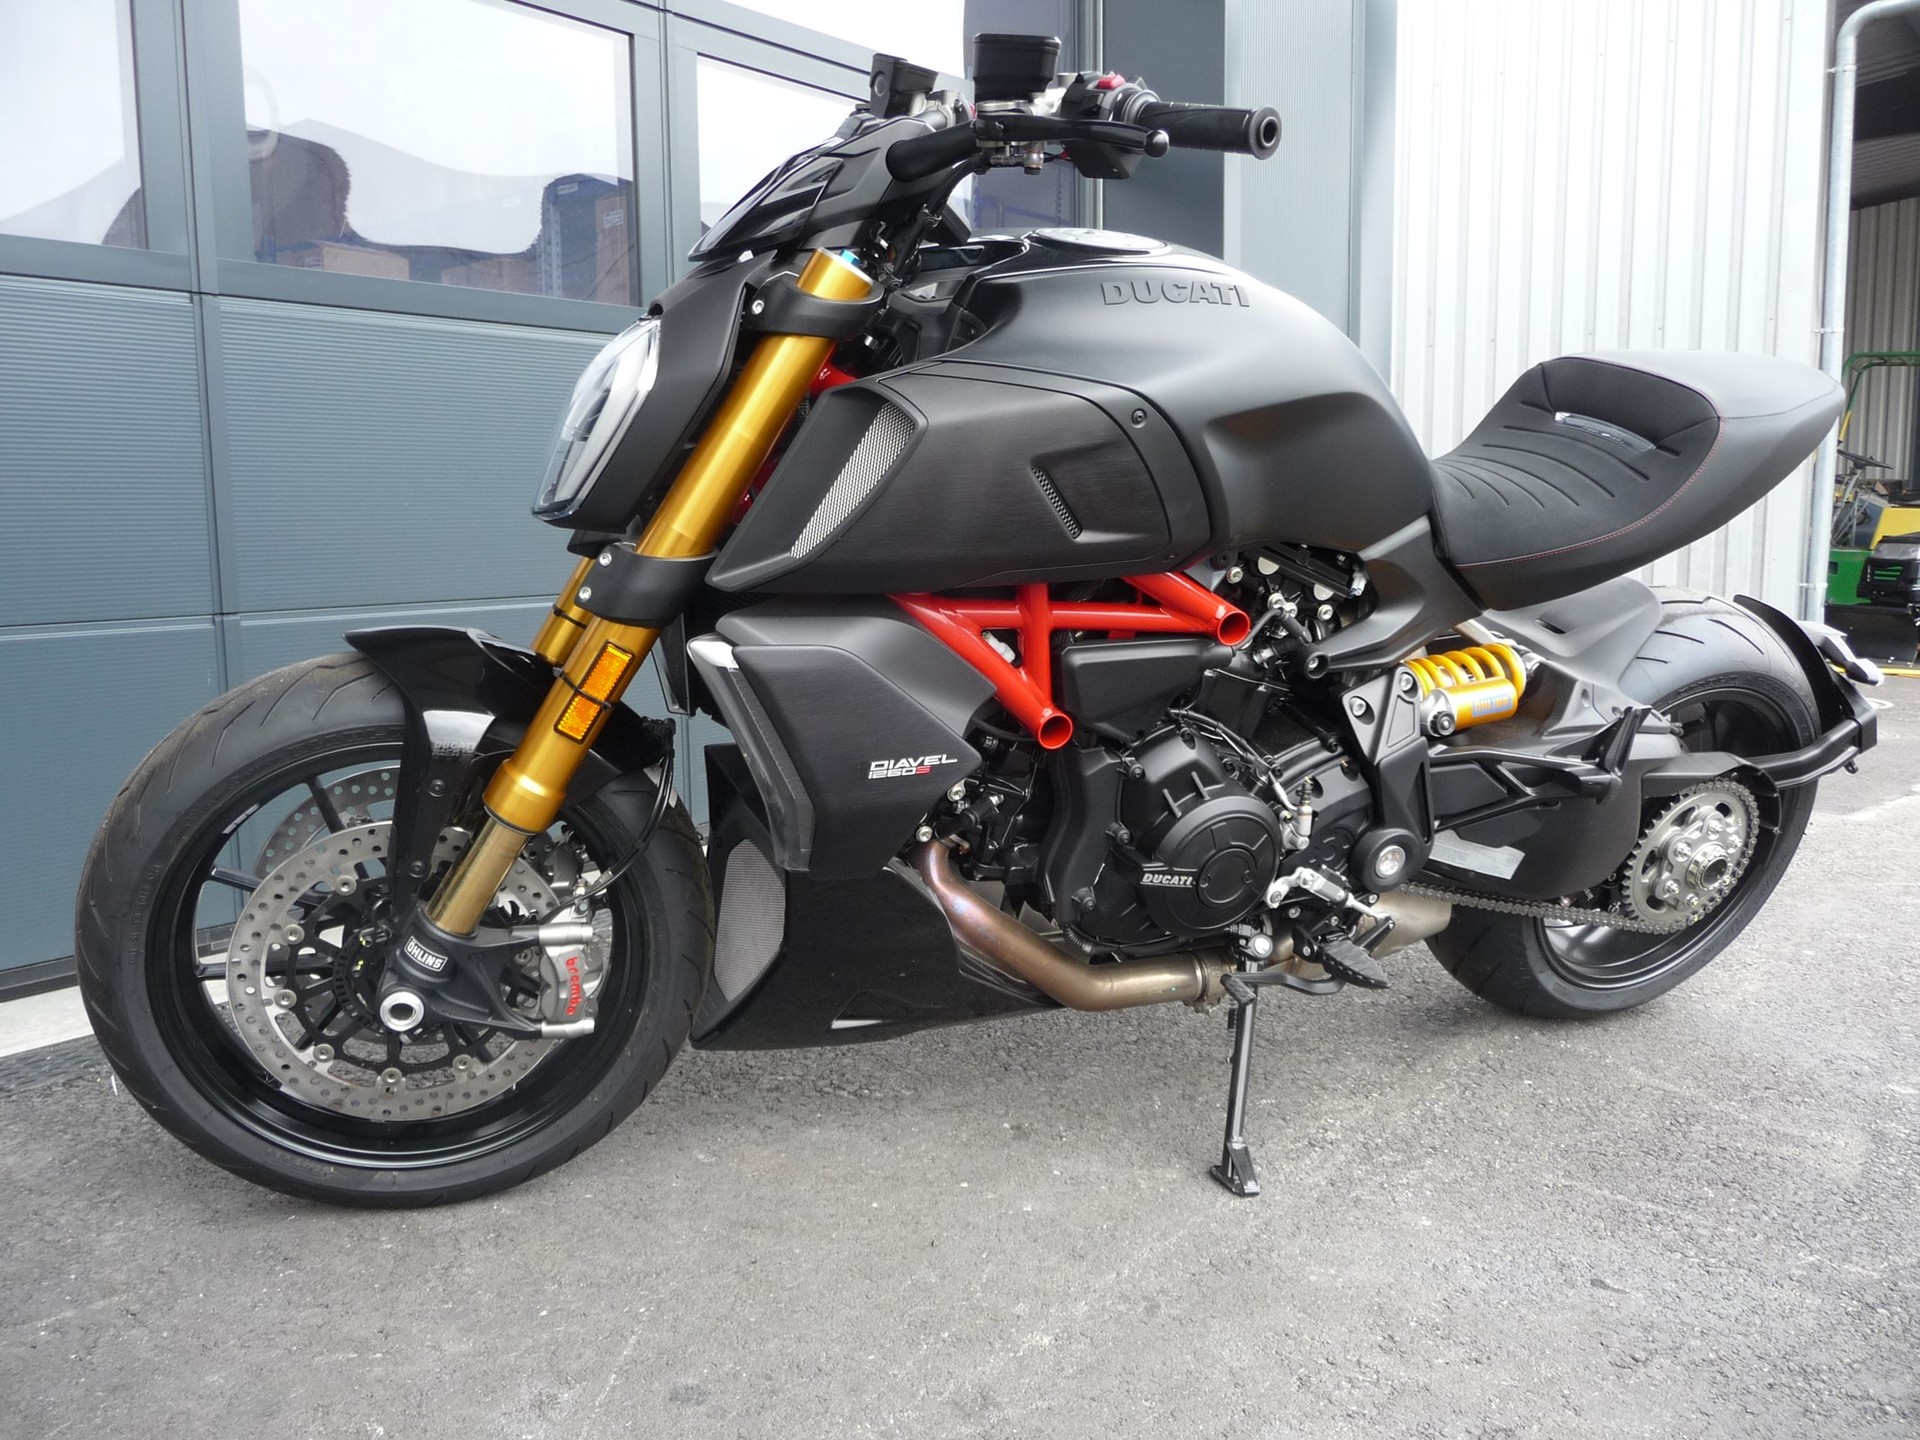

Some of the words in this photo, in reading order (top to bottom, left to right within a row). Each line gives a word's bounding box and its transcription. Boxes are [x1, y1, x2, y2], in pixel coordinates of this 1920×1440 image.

[1101, 280, 1250, 307] DUCATI
[870, 754, 958, 771] DIAVEL
[868, 765, 932, 779] 1260S
[1142, 873, 1193, 886] DUCATI
[566, 956, 583, 1016] brembo
